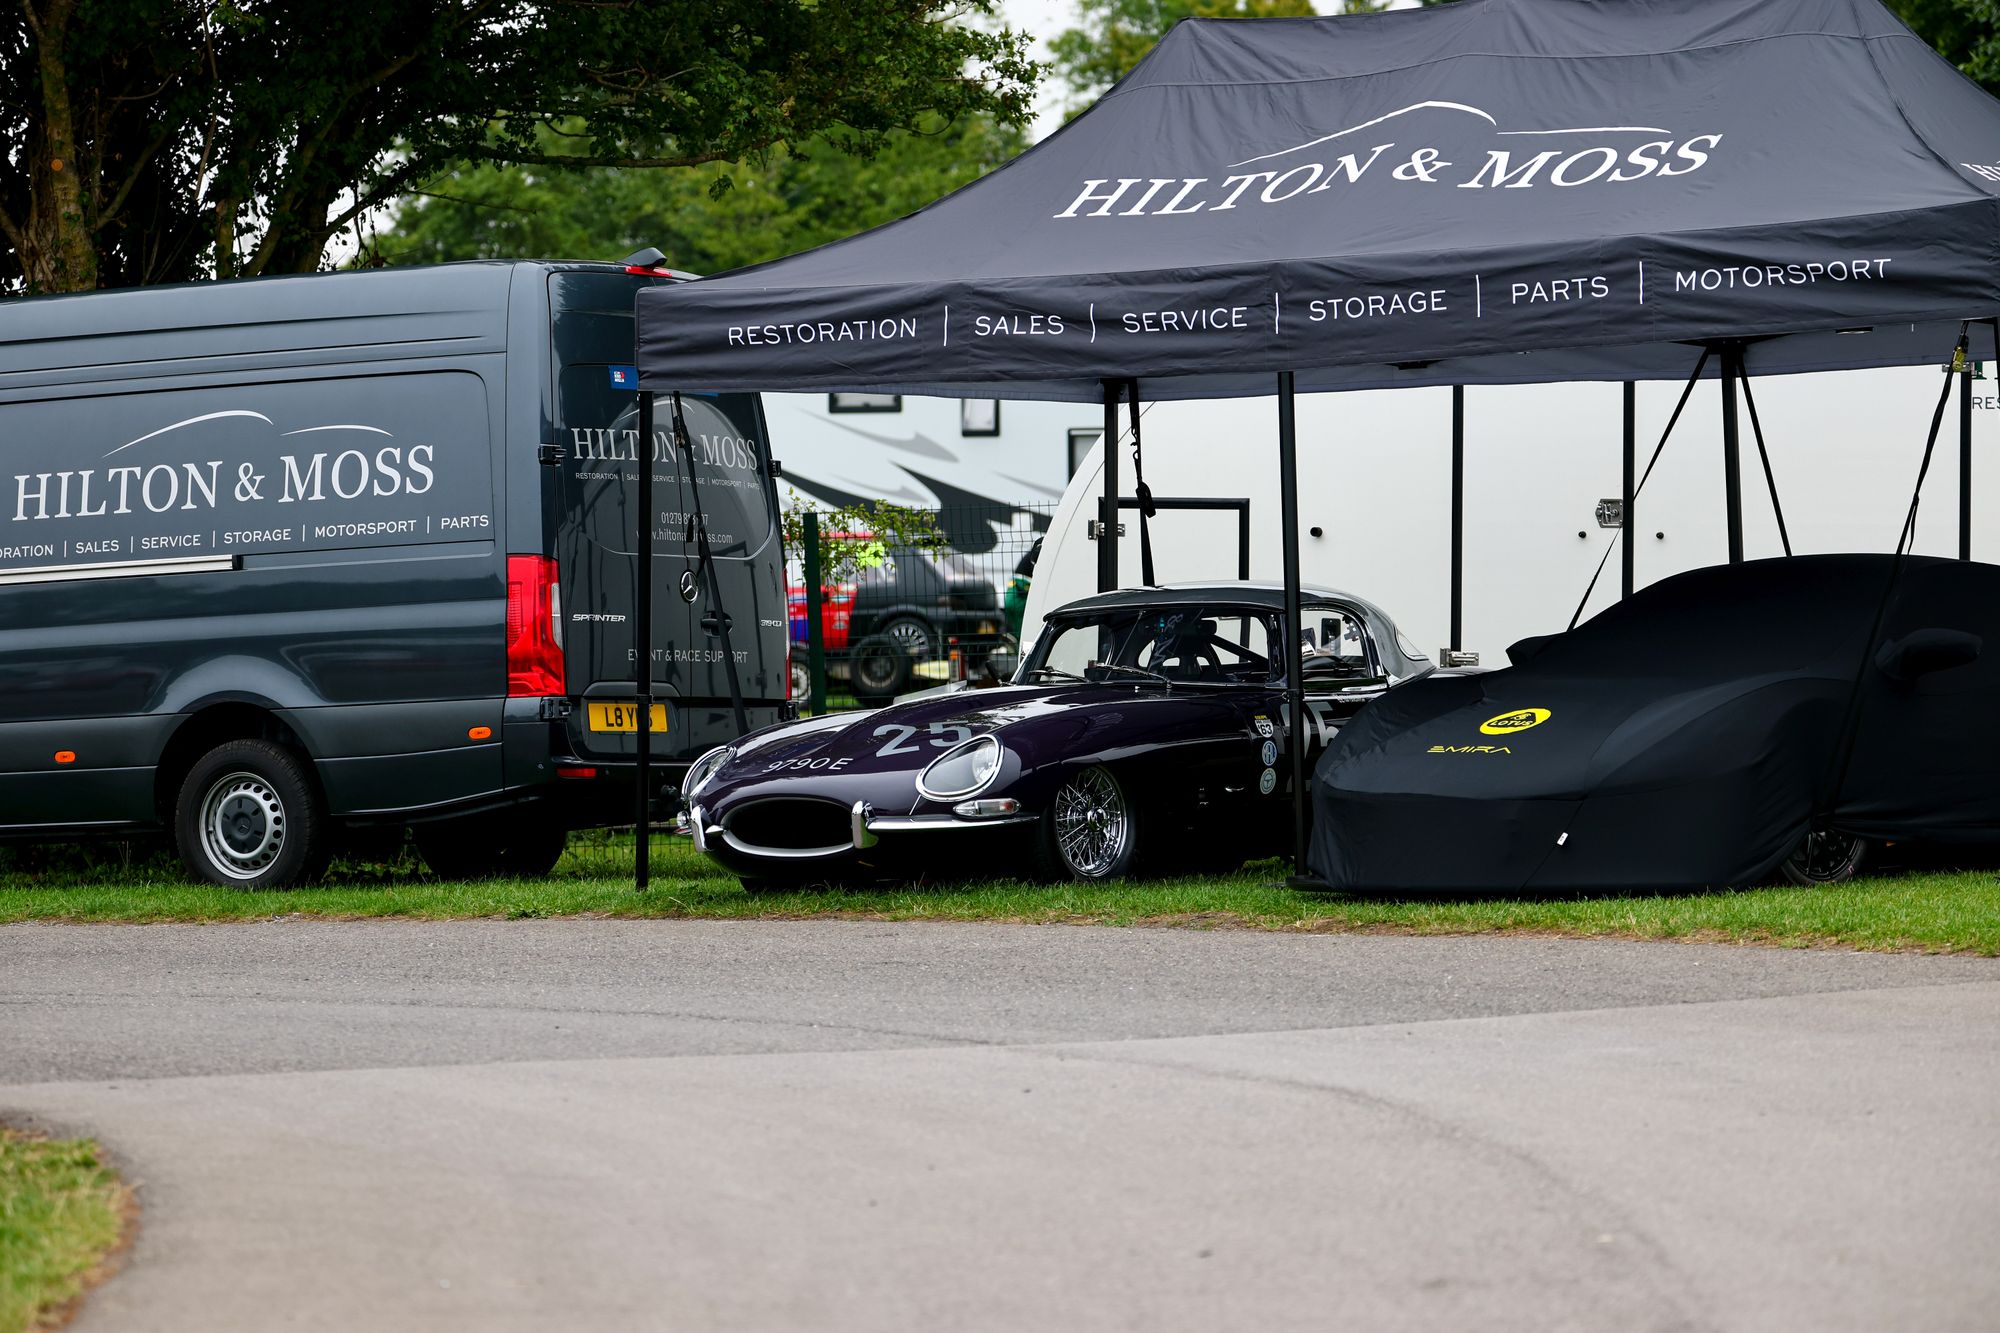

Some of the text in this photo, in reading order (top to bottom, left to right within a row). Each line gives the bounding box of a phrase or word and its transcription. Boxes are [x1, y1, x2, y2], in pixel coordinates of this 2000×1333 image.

[1053, 134, 1723, 219] HILTON & MOSS
[728, 258, 1892, 346] RESTORATION SALES SERVICE STORAGE PARTS MOTORSPORT
[700, 434, 757, 470] MOSS
[12, 444, 434, 521] HILTON & MOSS
[75, 539, 120, 554] SALES
[141, 534, 201, 550] SERVICE
[223, 528, 292, 545] STORAGE
[314, 519, 417, 538] MOTORSPORT
[440, 514, 489, 530] PARTS
[571, 613, 626, 622] SPRINTER
[674, 650, 701, 662] RACE
[872, 719, 972, 758] 25
